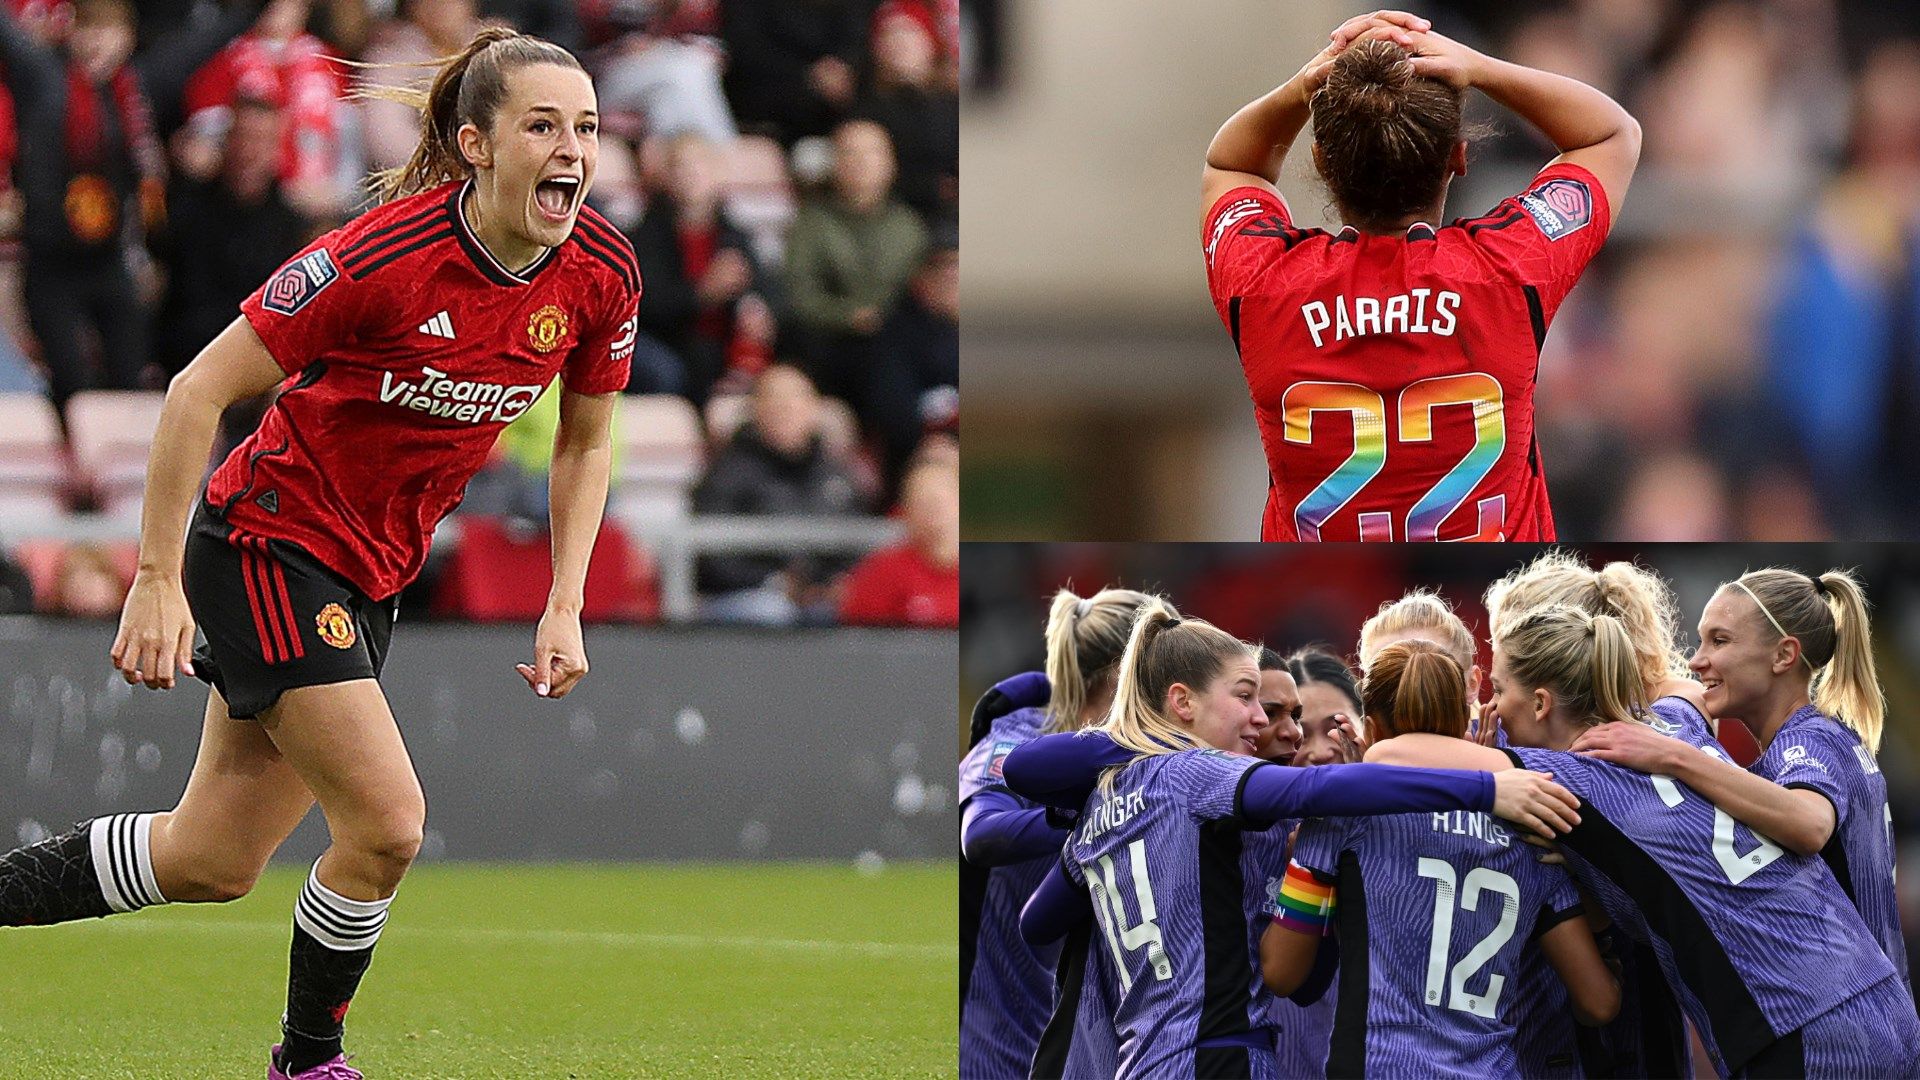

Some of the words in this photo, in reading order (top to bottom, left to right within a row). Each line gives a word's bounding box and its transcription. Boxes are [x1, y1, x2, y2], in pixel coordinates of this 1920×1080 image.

[1301, 288, 1461, 348] PARRIS
[379, 371, 492, 424] Viewer
[419, 366, 503, 403] Team
[1282, 372, 1506, 542] 22
[1083, 838, 1173, 994] 14
[1418, 857, 1520, 1018] 12
